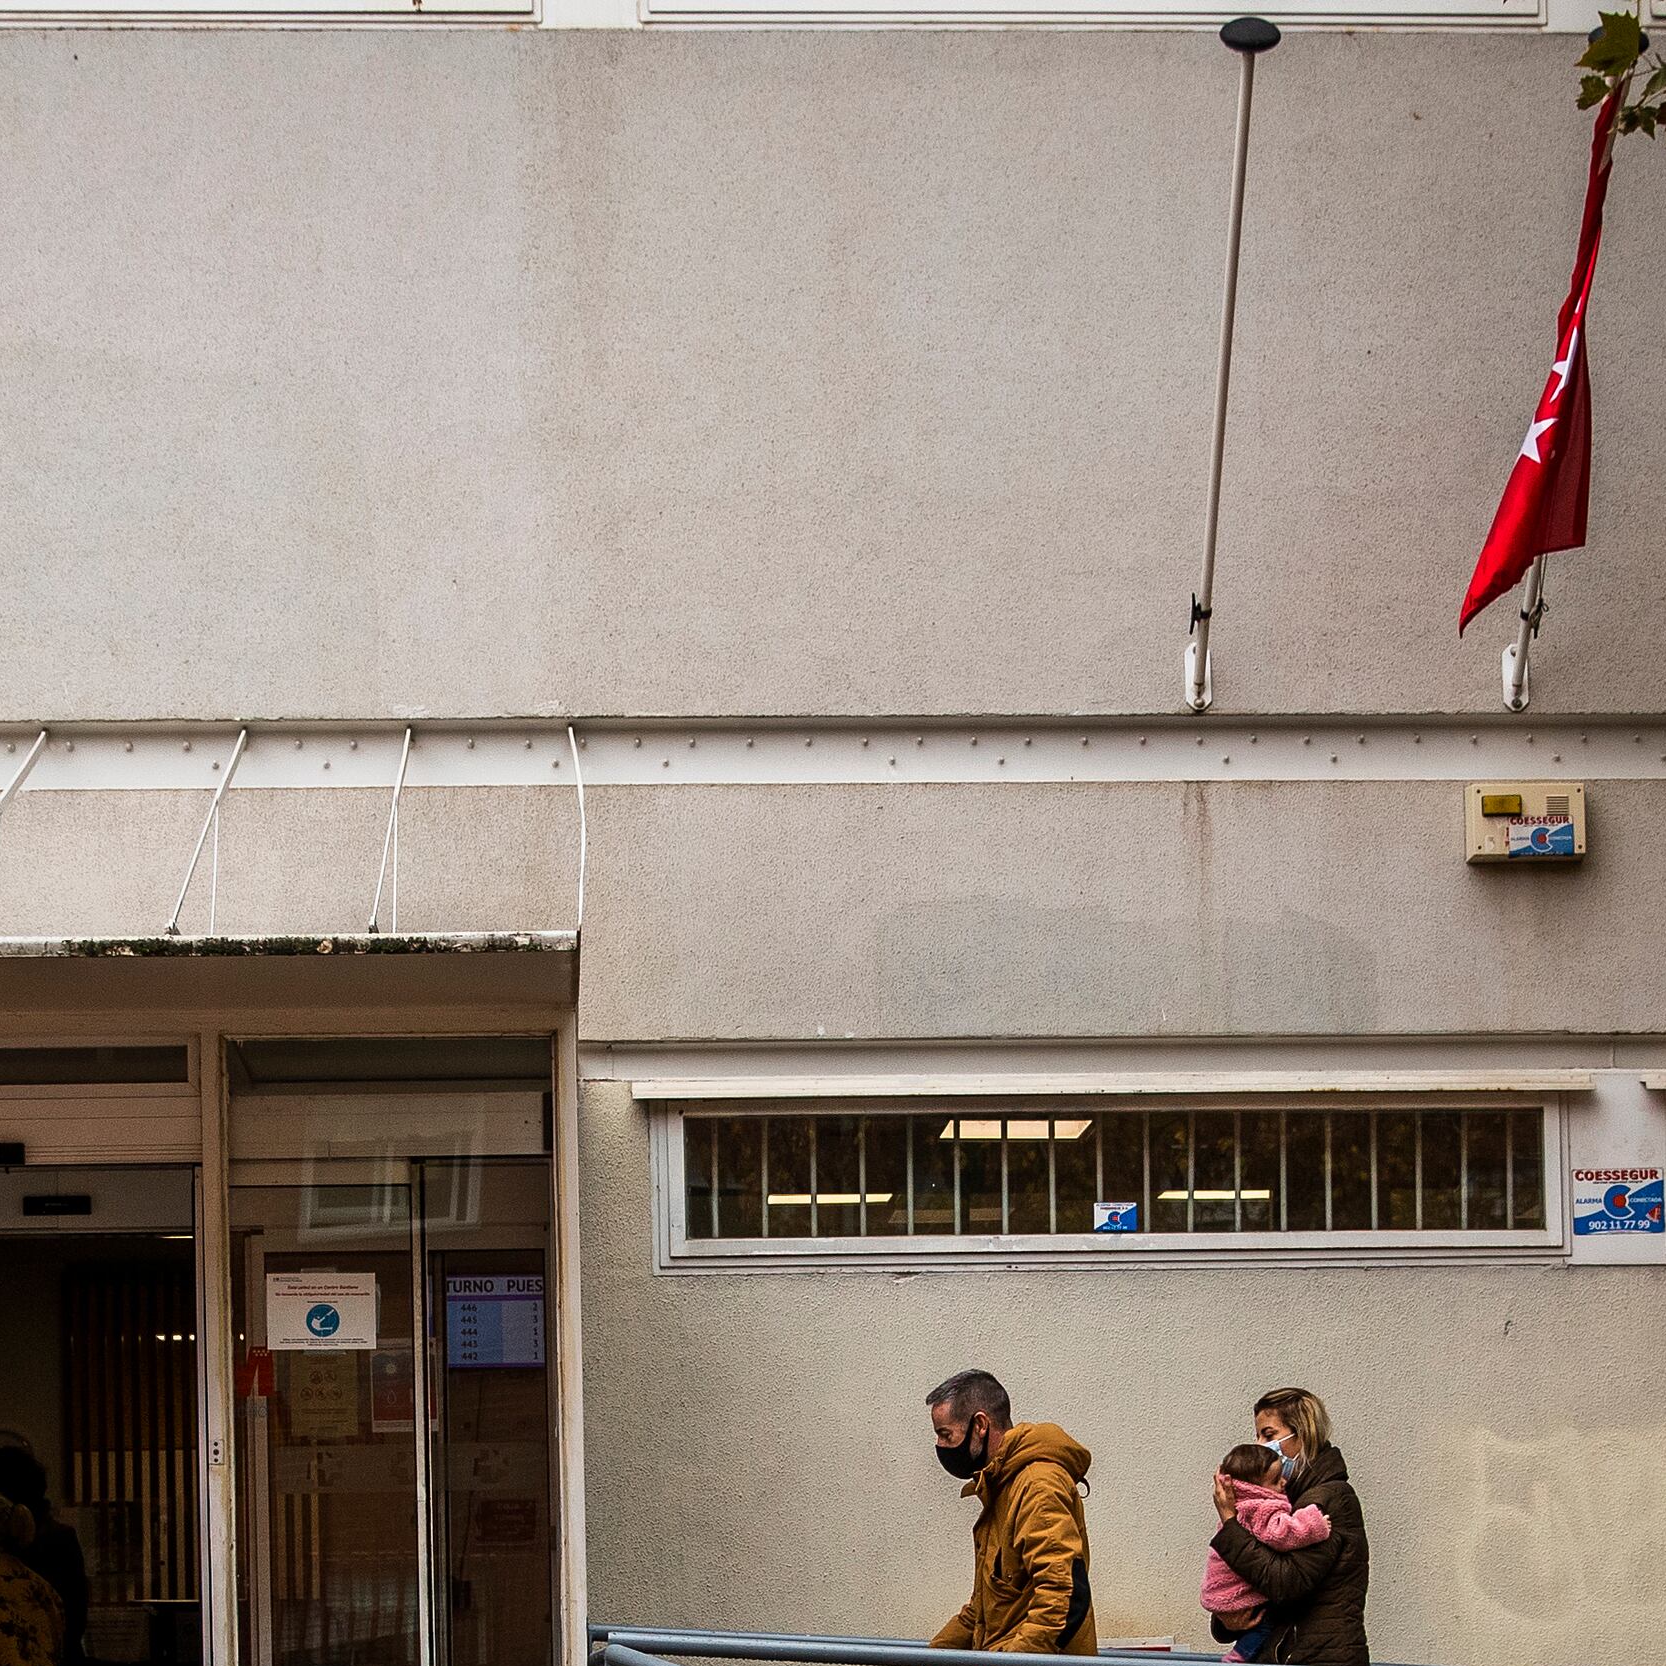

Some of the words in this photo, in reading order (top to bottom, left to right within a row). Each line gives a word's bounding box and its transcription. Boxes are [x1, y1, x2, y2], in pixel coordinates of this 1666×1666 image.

[1510, 816, 1570, 825] COESSEGUR
[1575, 1169, 1659, 1181] COESSEGUR
[1588, 1221, 1608, 1230] 902
[1610, 1221, 1622, 1230] 11
[1623, 1220, 1636, 1229] 77
[1637, 1220, 1651, 1230] 99
[460, 1304, 478, 1312] 446
[532, 1302, 538, 1311] 2
[460, 1316, 478, 1324] 445
[460, 1352, 478, 1361] 442
[533, 1351, 538, 1360] 1
